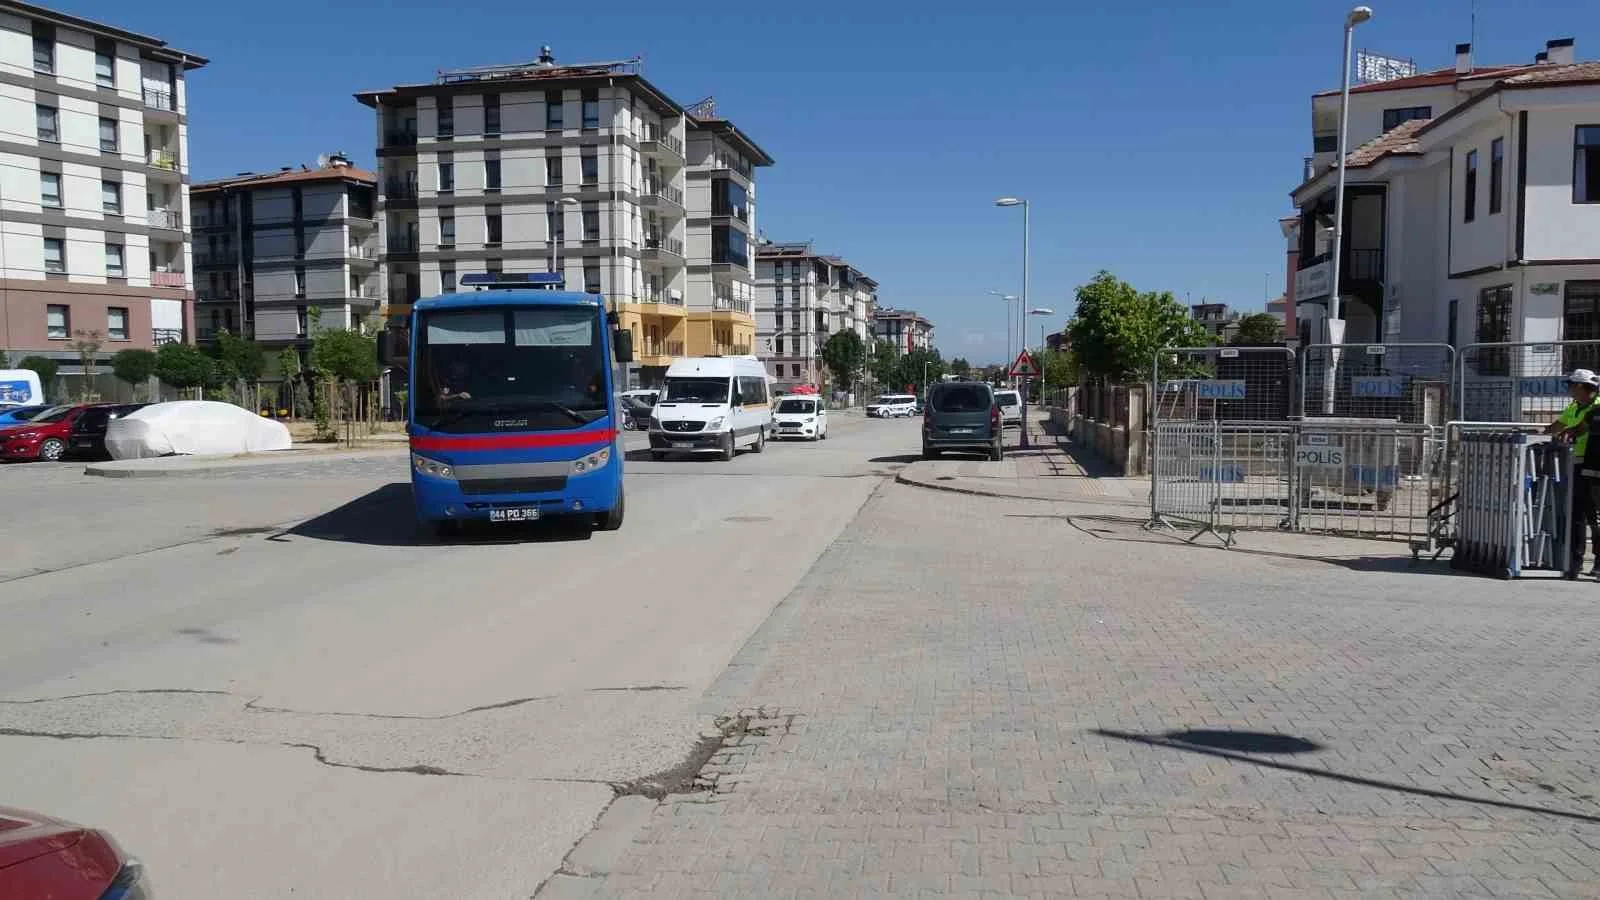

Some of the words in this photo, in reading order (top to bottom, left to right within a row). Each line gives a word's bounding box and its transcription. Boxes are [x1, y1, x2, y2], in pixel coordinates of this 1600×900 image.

[1199, 380, 1247, 397] POLİS
[1355, 378, 1403, 396] POLİS
[1296, 450, 1343, 464] POLİS
